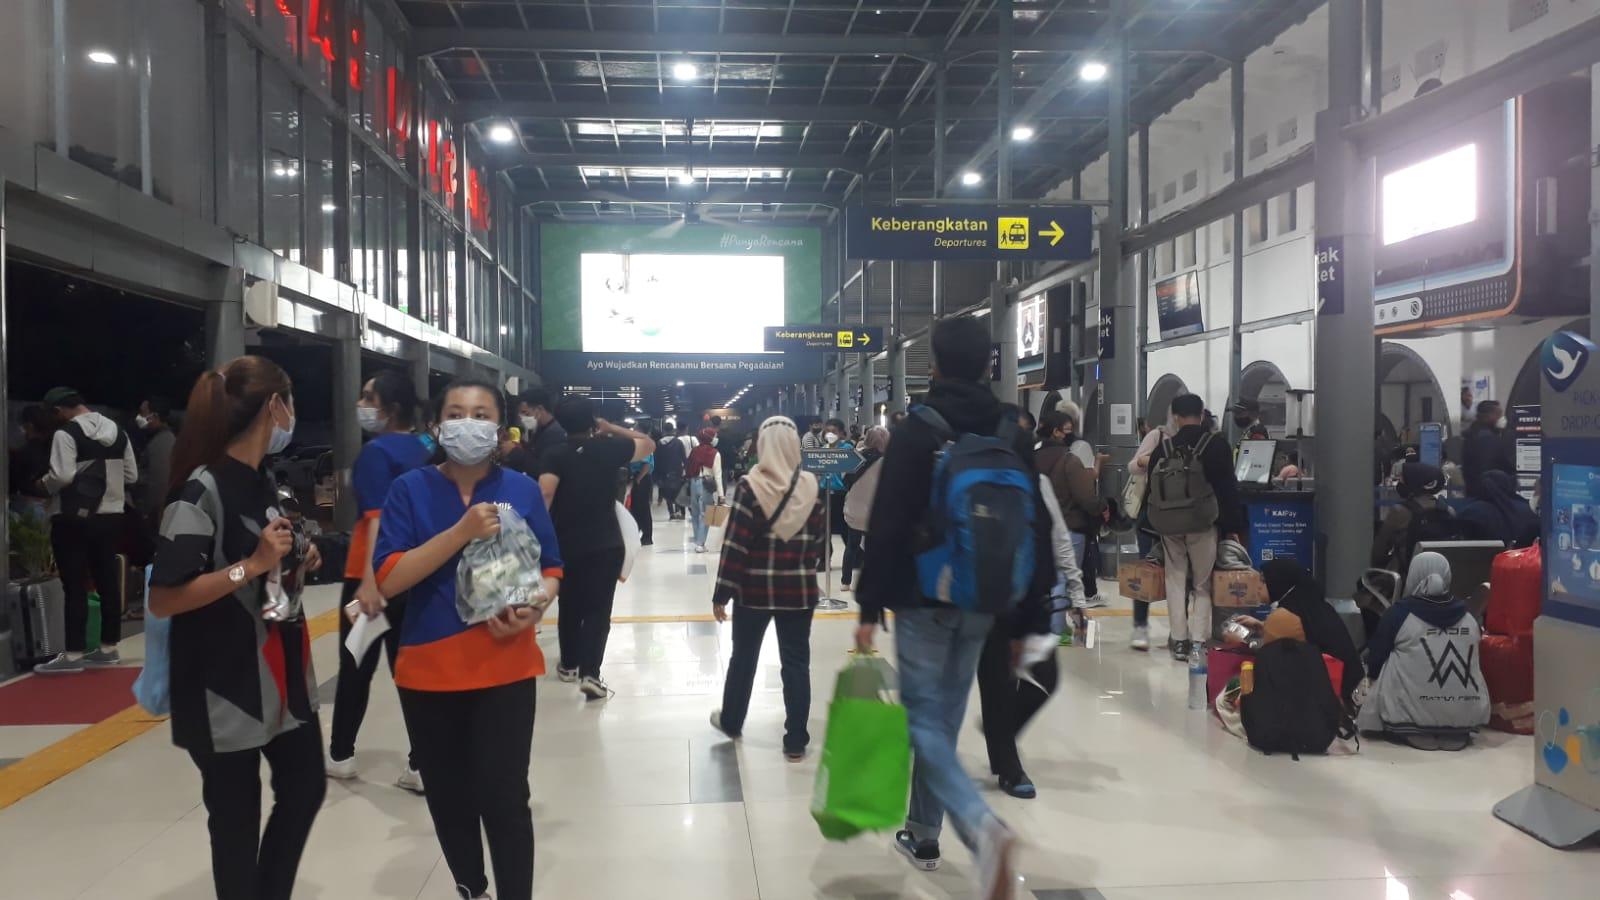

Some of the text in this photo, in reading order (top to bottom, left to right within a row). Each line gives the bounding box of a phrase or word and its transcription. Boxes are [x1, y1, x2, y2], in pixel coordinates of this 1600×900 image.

[871, 217, 988, 233] Keberangkatan
[719, 232, 804, 250] #PunyaRencana
[934, 237, 987, 248] Departures
[775, 331, 833, 340] Keberangkatan
[586, 360, 784, 371] Ayo Wujudkan Rencanamu Bersama Pegadaian!
